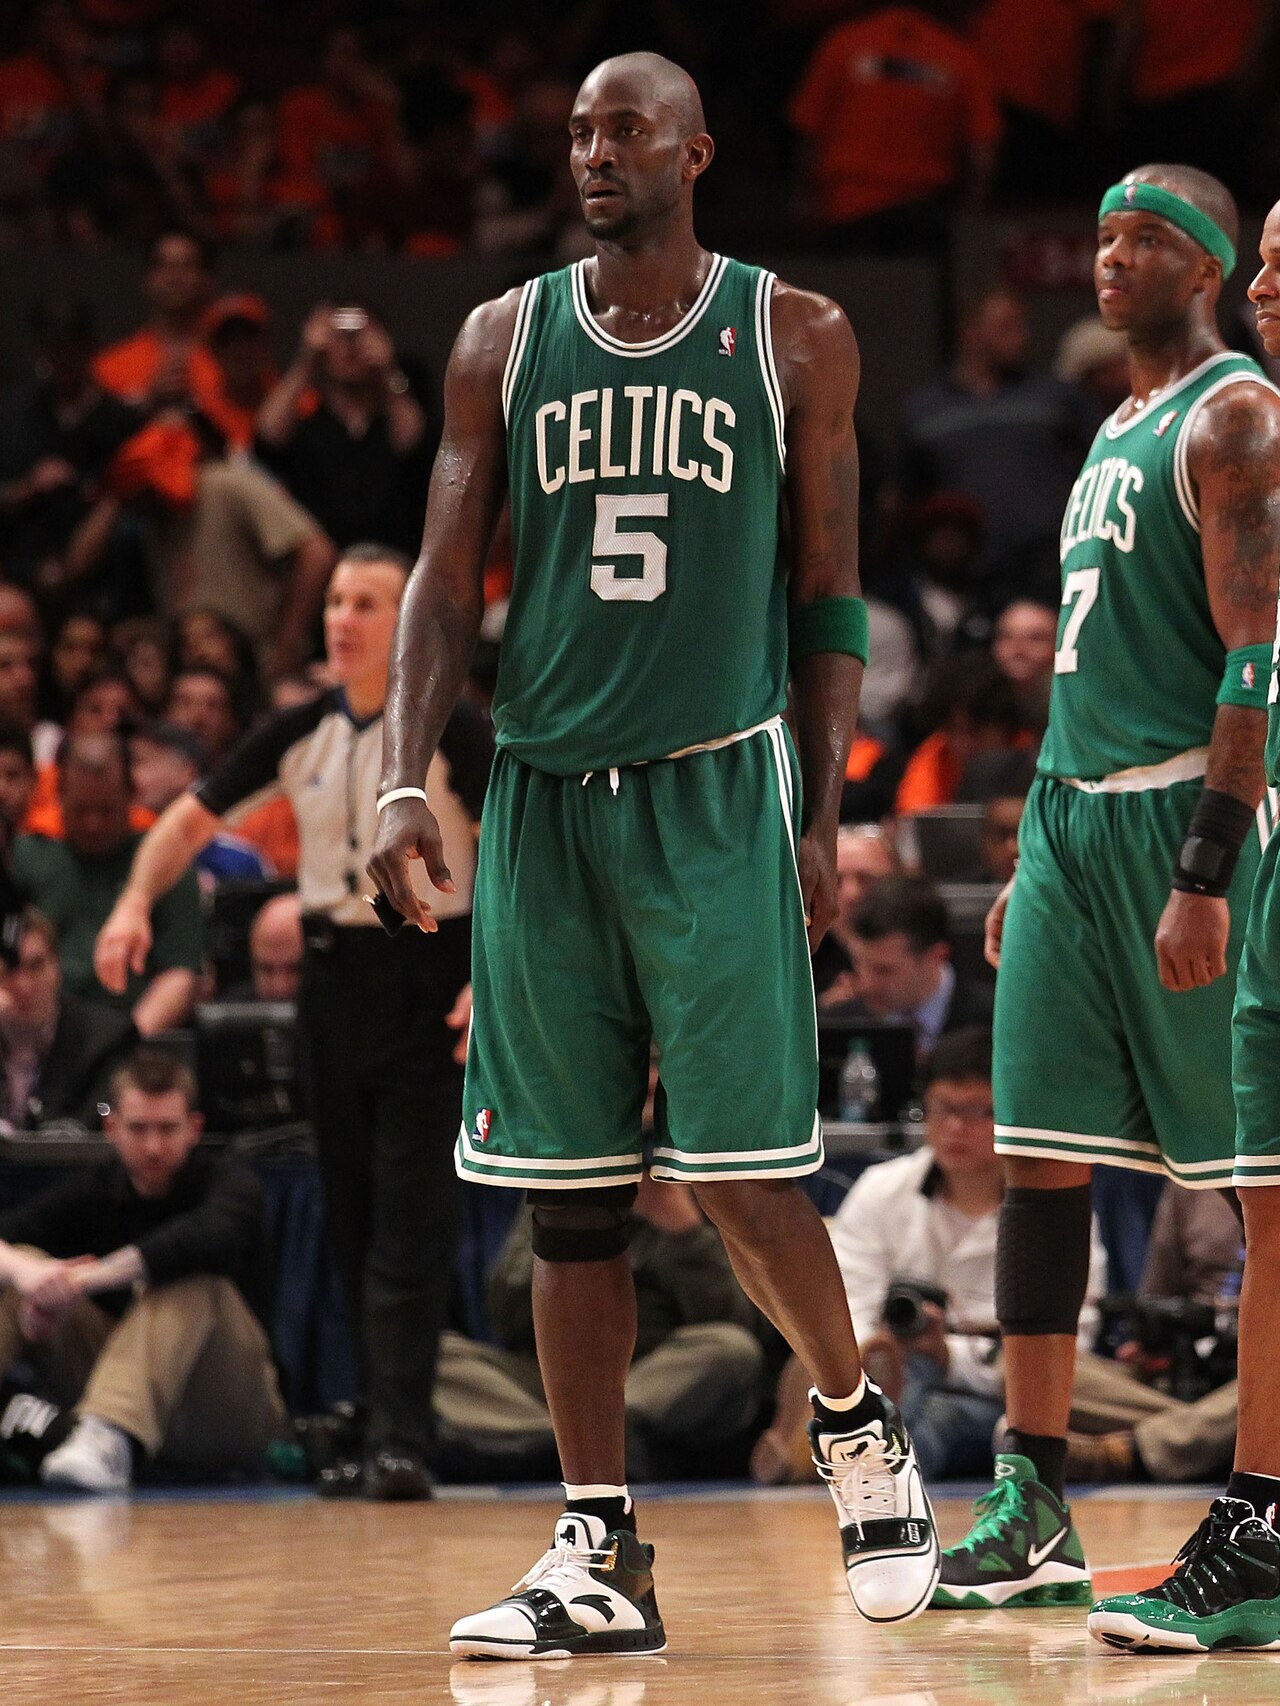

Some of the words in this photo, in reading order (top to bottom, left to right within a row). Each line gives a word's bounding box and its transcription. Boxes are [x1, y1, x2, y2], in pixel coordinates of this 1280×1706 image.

[535, 386, 736, 494] CELTICS
[590, 493, 669, 601] 5
[1055, 567, 1100, 674] 7
